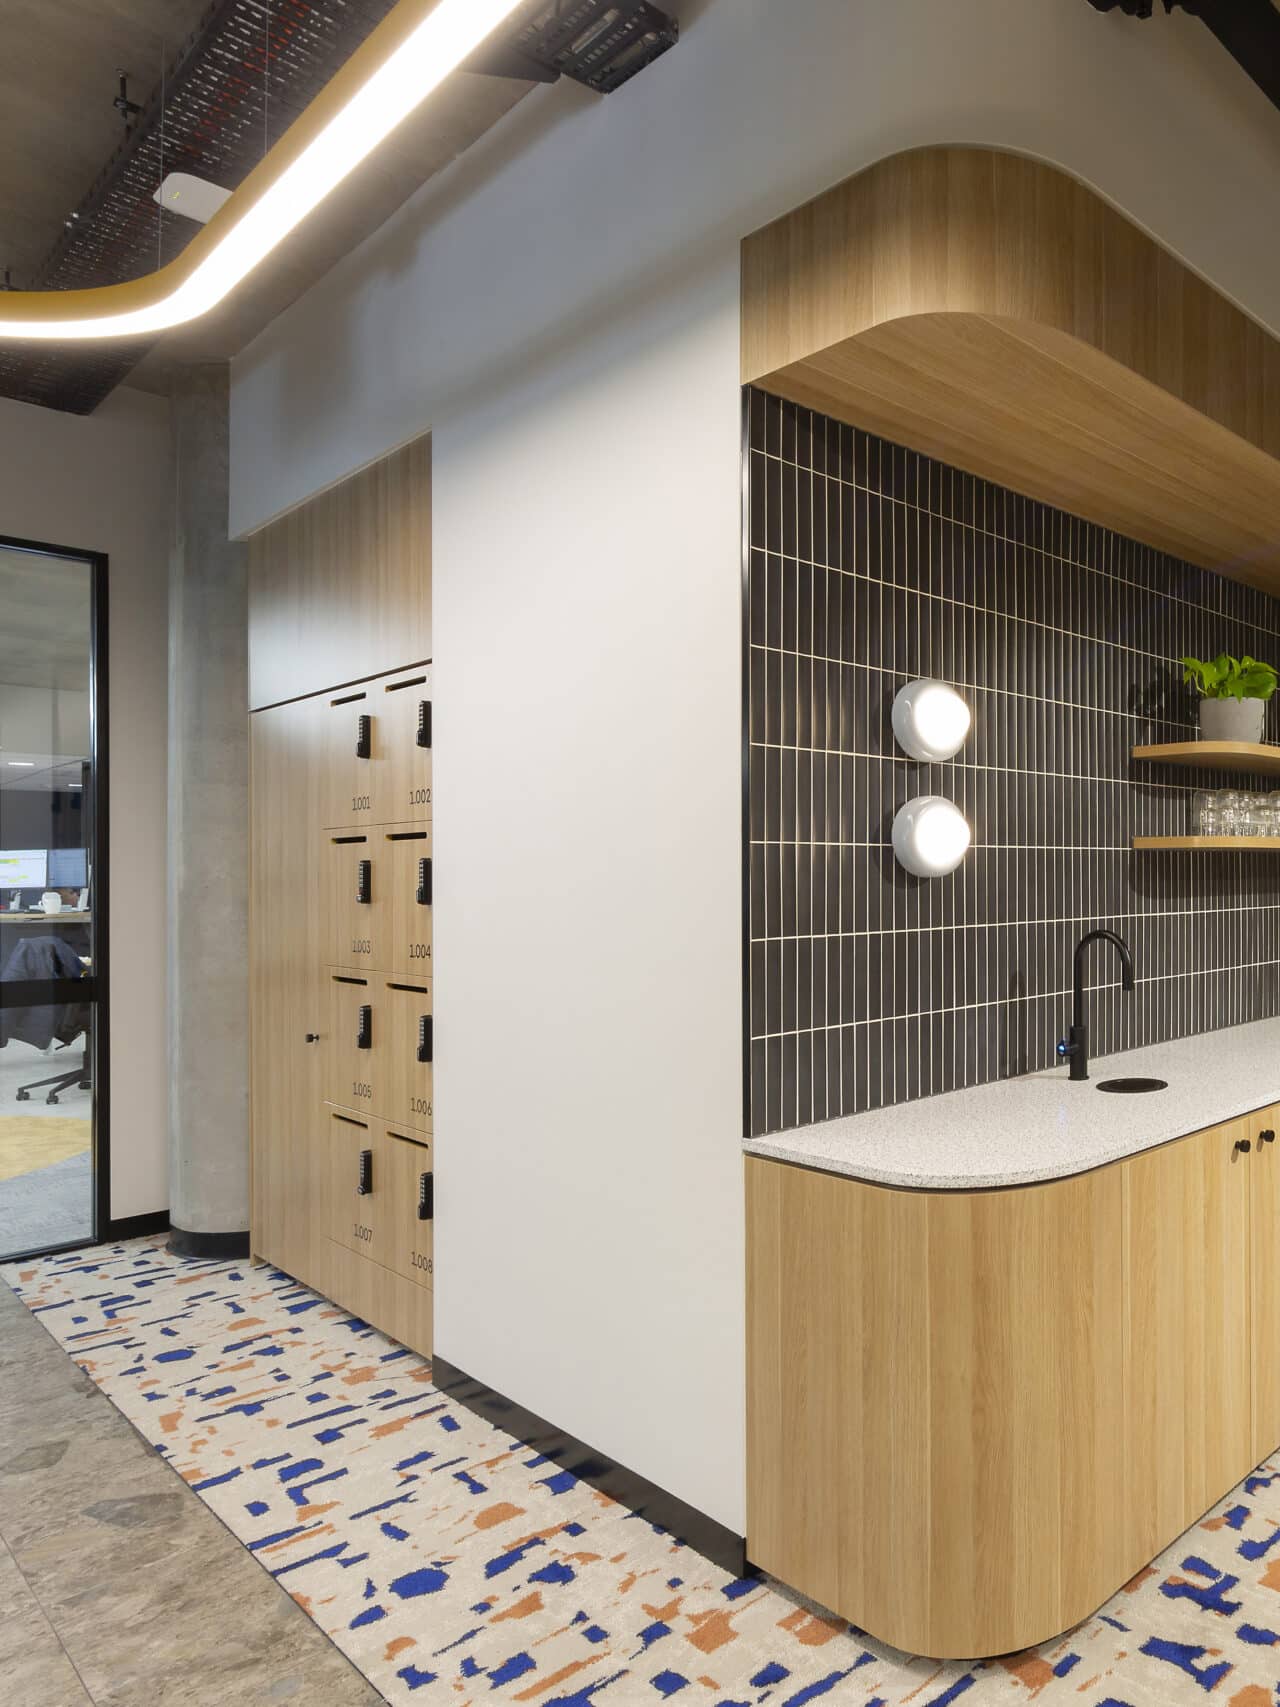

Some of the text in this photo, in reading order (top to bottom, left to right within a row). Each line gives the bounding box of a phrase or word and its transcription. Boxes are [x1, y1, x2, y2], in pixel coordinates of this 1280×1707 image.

[408, 787, 432, 806] 1.002
[408, 943, 431, 959] 1.004
[410, 1096, 433, 1117] 1.006
[353, 1223, 373, 1244] 1.007
[410, 1250, 433, 1274] 1.008
